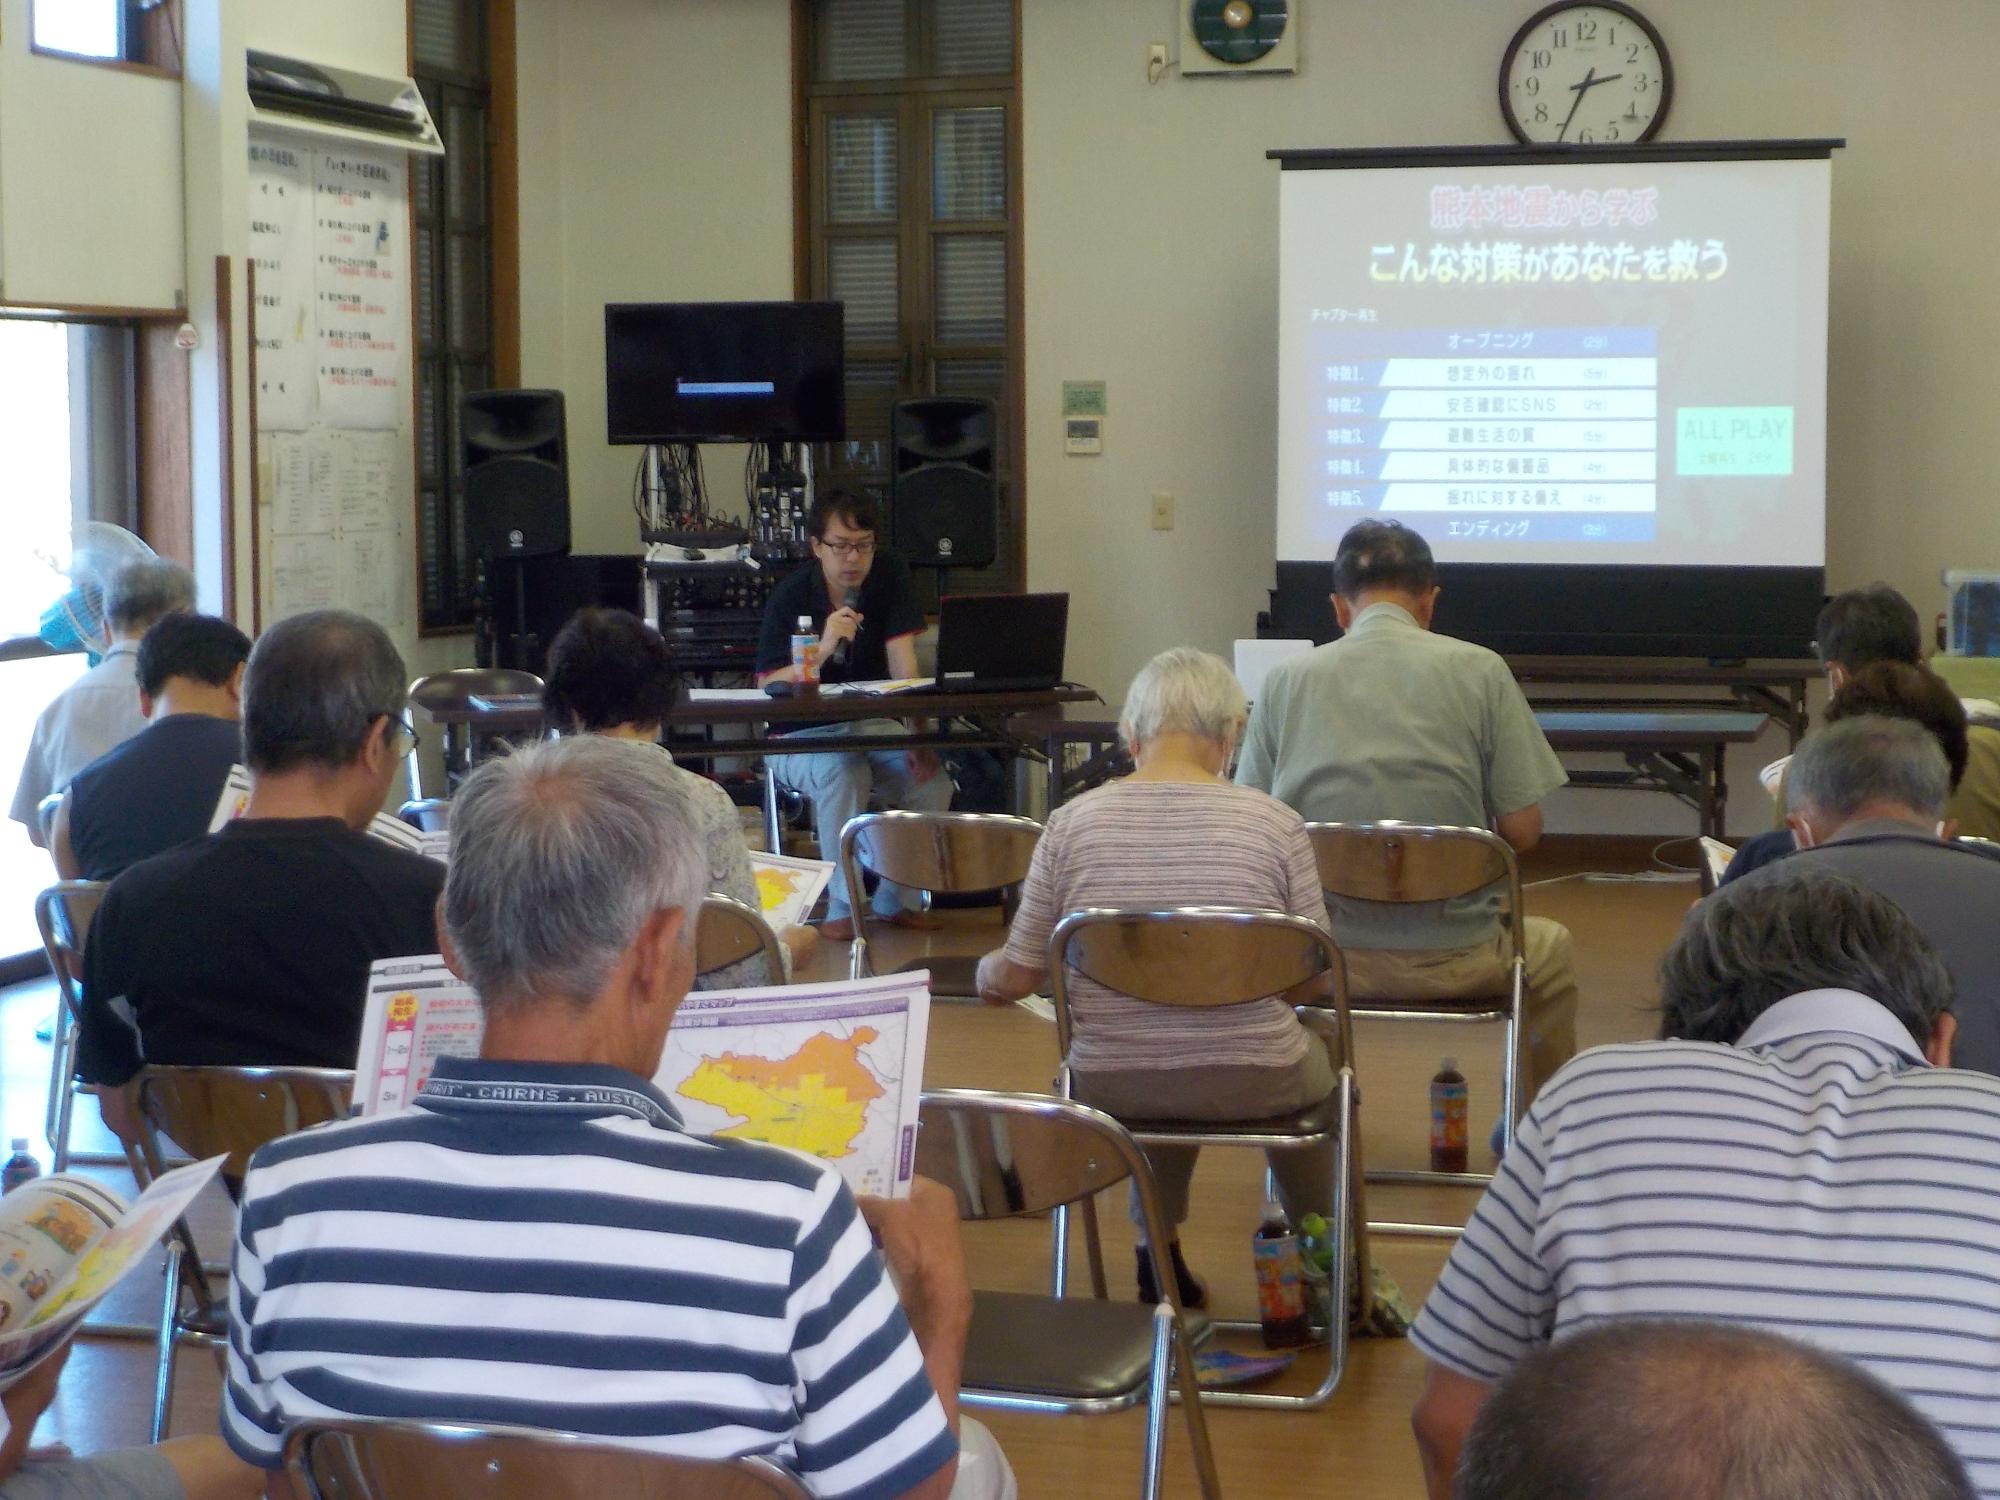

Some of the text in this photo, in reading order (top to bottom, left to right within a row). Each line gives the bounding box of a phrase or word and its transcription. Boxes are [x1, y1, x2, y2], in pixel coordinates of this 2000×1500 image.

[1553, 29, 1567, 48] 11
[1576, 20, 1598, 41] 12
[1608, 26, 1616, 46] 1
[1532, 50, 1551, 69] 10
[1626, 43, 1639, 63] 2
[1526, 76, 1540, 96] 9
[1634, 71, 1648, 93] 3
[1534, 103, 1549, 123] 8
[1622, 100, 1638, 119] 4
[1579, 128, 1593, 144] 6
[1606, 121, 1619, 141] 5
[1430, 183, 1658, 230] 熊本地震から学ぶ
[1369, 239, 1729, 284] こんな対策があなたを救う
[1448, 332, 1535, 349] オープニング
[1684, 417, 1788, 440] ALL PLAY
[1448, 519, 1531, 537] エンディング
[479, 1086, 560, 1102] CAIRNS
